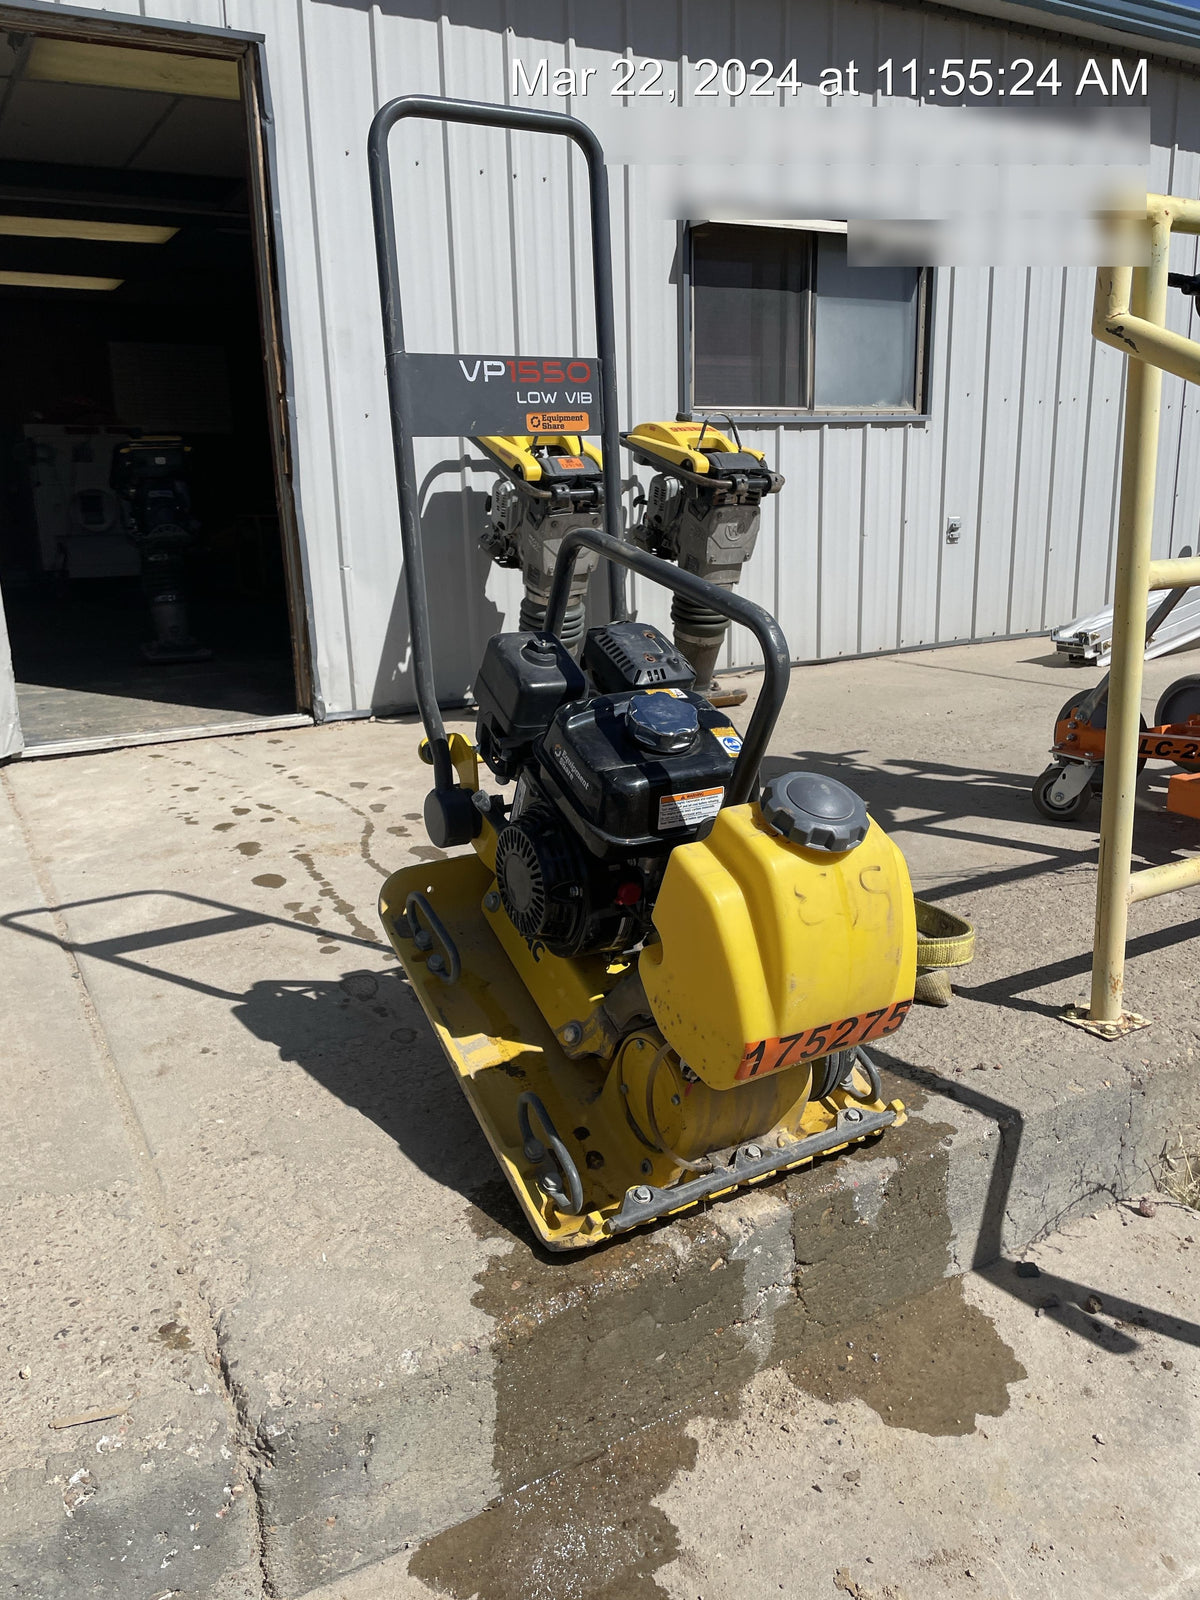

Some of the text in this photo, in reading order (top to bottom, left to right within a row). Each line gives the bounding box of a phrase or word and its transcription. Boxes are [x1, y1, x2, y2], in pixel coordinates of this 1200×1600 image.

[459, 360, 591, 383] VP1550
[516, 391, 593, 404] LOW VIB
[541, 414, 583, 423] Equipment
[541, 422, 565, 430] Share
[1140, 738, 1200, 759] LC-2
[559, 757, 574, 781] Share
[562, 750, 590, 790] Equipment
[748, 1000, 913, 1076] 175275
